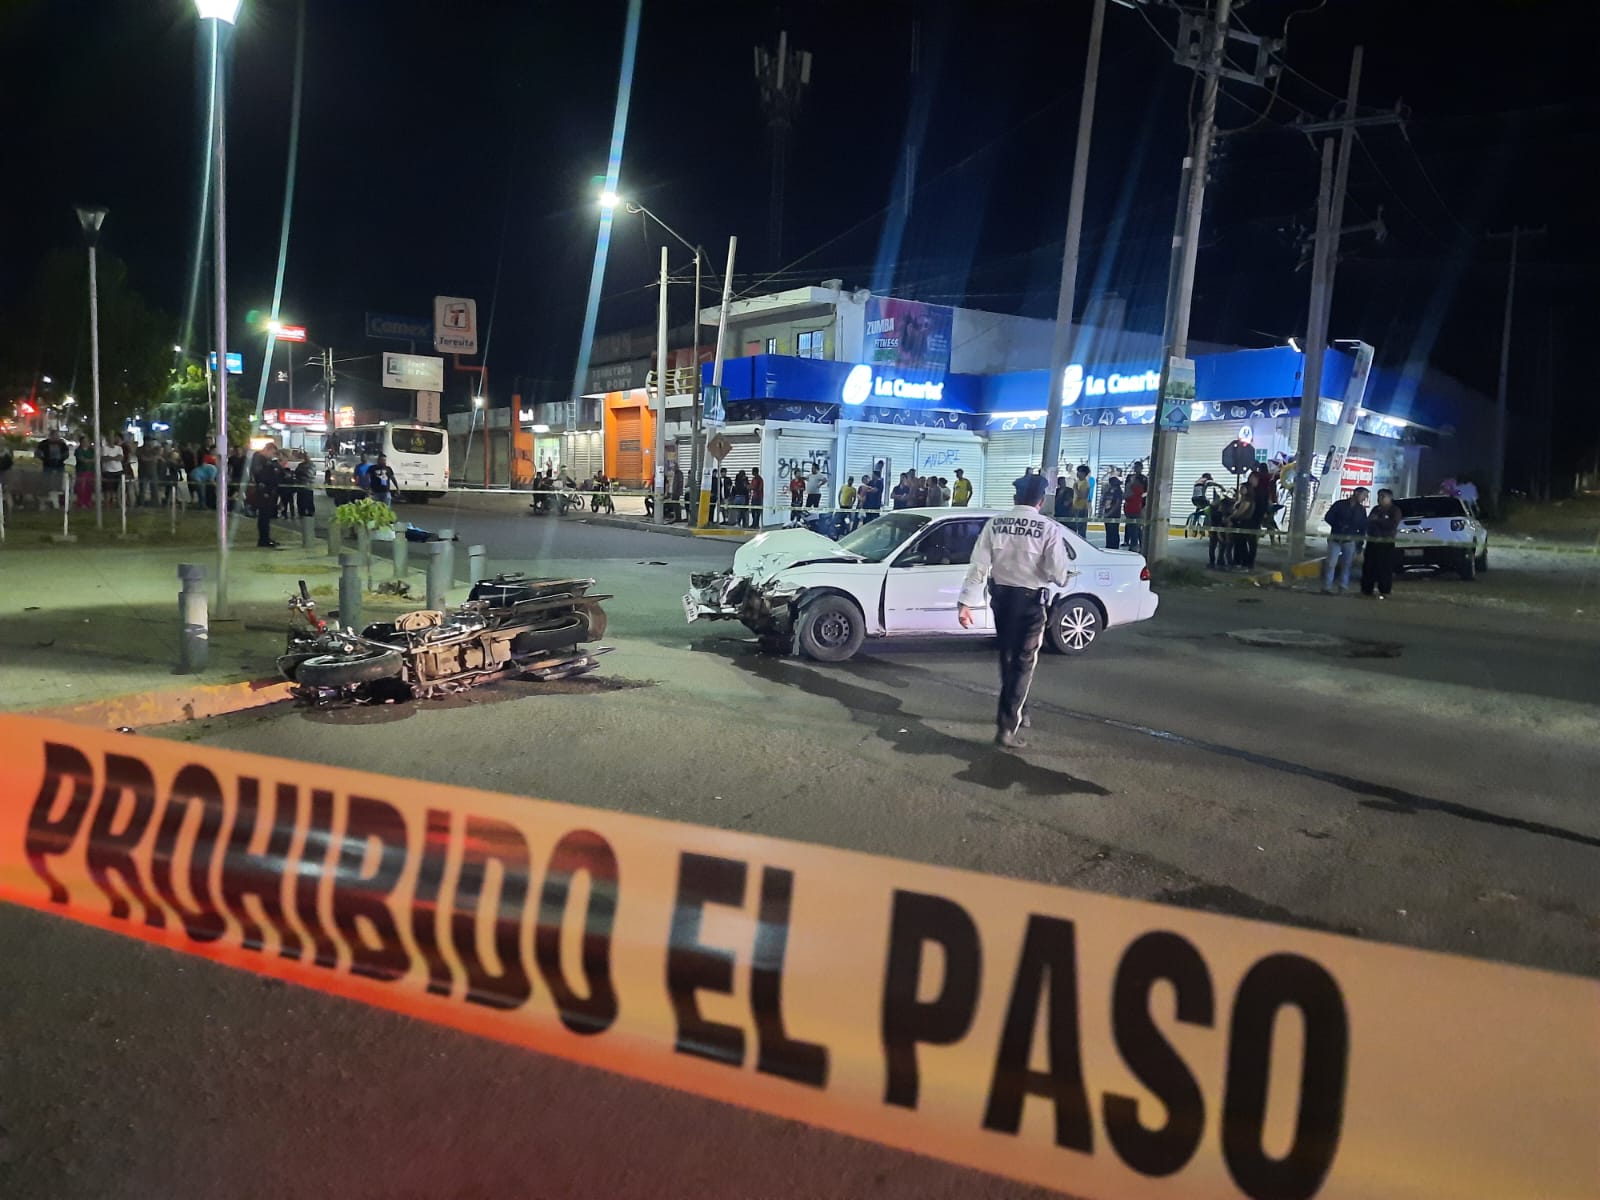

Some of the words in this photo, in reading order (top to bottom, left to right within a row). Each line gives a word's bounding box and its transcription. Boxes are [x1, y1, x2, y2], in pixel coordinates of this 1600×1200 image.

[866, 317, 895, 336] ZUMBA
[874, 338, 899, 348] FITNESS
[875, 376, 893, 396] La
[1086, 375, 1106, 395] La
[992, 525, 1041, 539] VIALIDAD
[993, 518, 1028, 527] UNIDAD
[1029, 519, 1045, 529] DE
[25, 741, 619, 1035] PROHIBIDO
[666, 852, 828, 1089] EL
[882, 889, 1350, 1200] PASO
